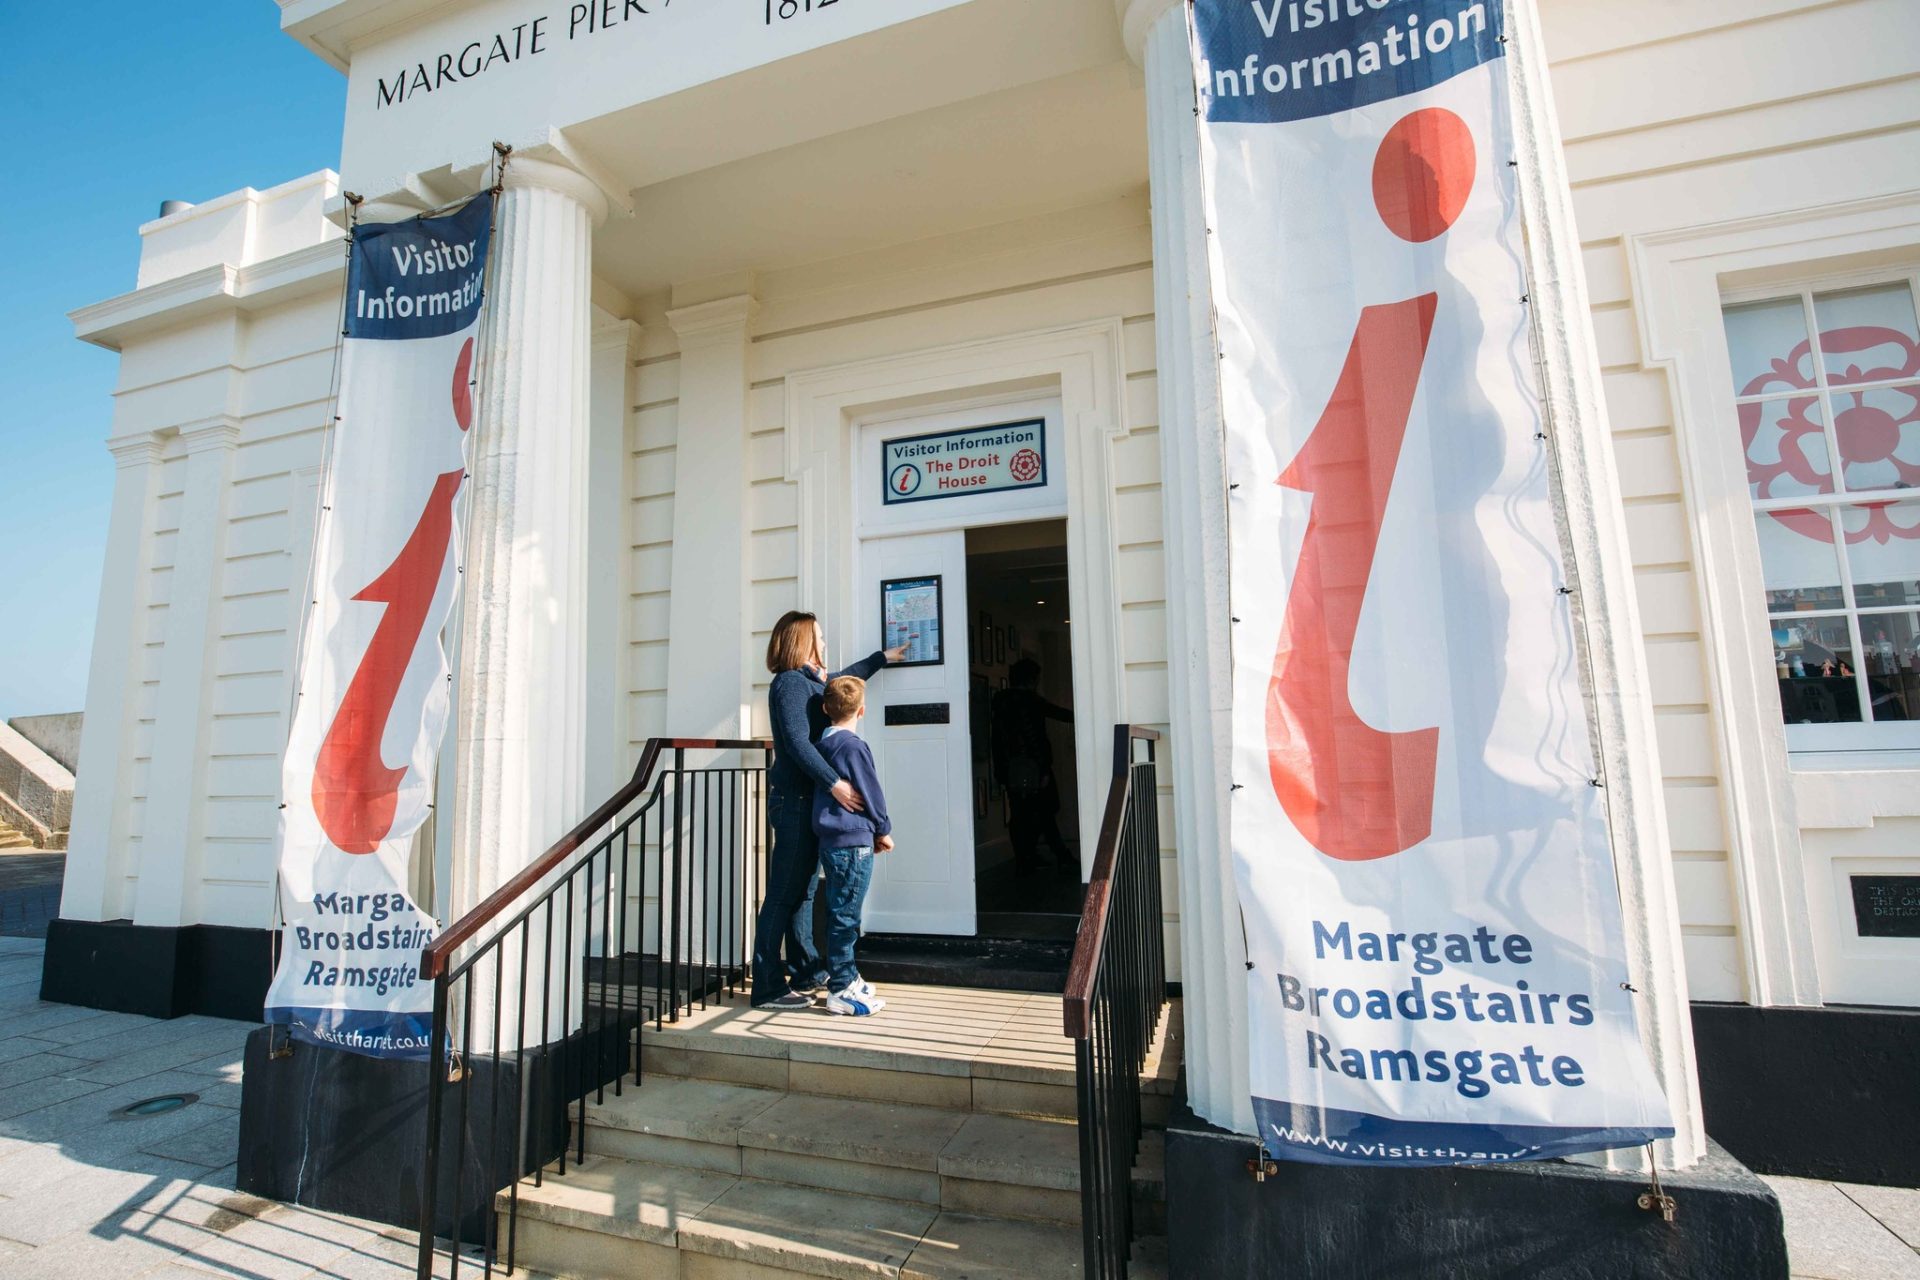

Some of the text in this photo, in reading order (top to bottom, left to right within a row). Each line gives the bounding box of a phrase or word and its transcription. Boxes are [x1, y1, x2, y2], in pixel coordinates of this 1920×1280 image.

[766, 0, 839, 25] 18
[1251, 0, 1403, 38] Visi
[377, 0, 649, 109] MARGATE PIER
[1200, 2, 1486, 97] Information
[392, 239, 476, 276] Visitor
[894, 431, 1034, 458] Visitor Information
[925, 453, 1000, 474] The Droit
[938, 475, 987, 489] House
[313, 891, 415, 922] Marga
[1870, 896, 1895, 906] THE
[1873, 907, 1920, 917] DESTRO
[296, 921, 433, 951] Broadstairs
[1312, 920, 1534, 976] Margate
[303, 960, 417, 997] Ramsgate
[1277, 973, 1595, 1027] Broadstairs
[1307, 1030, 1586, 1099] Ramsgate
